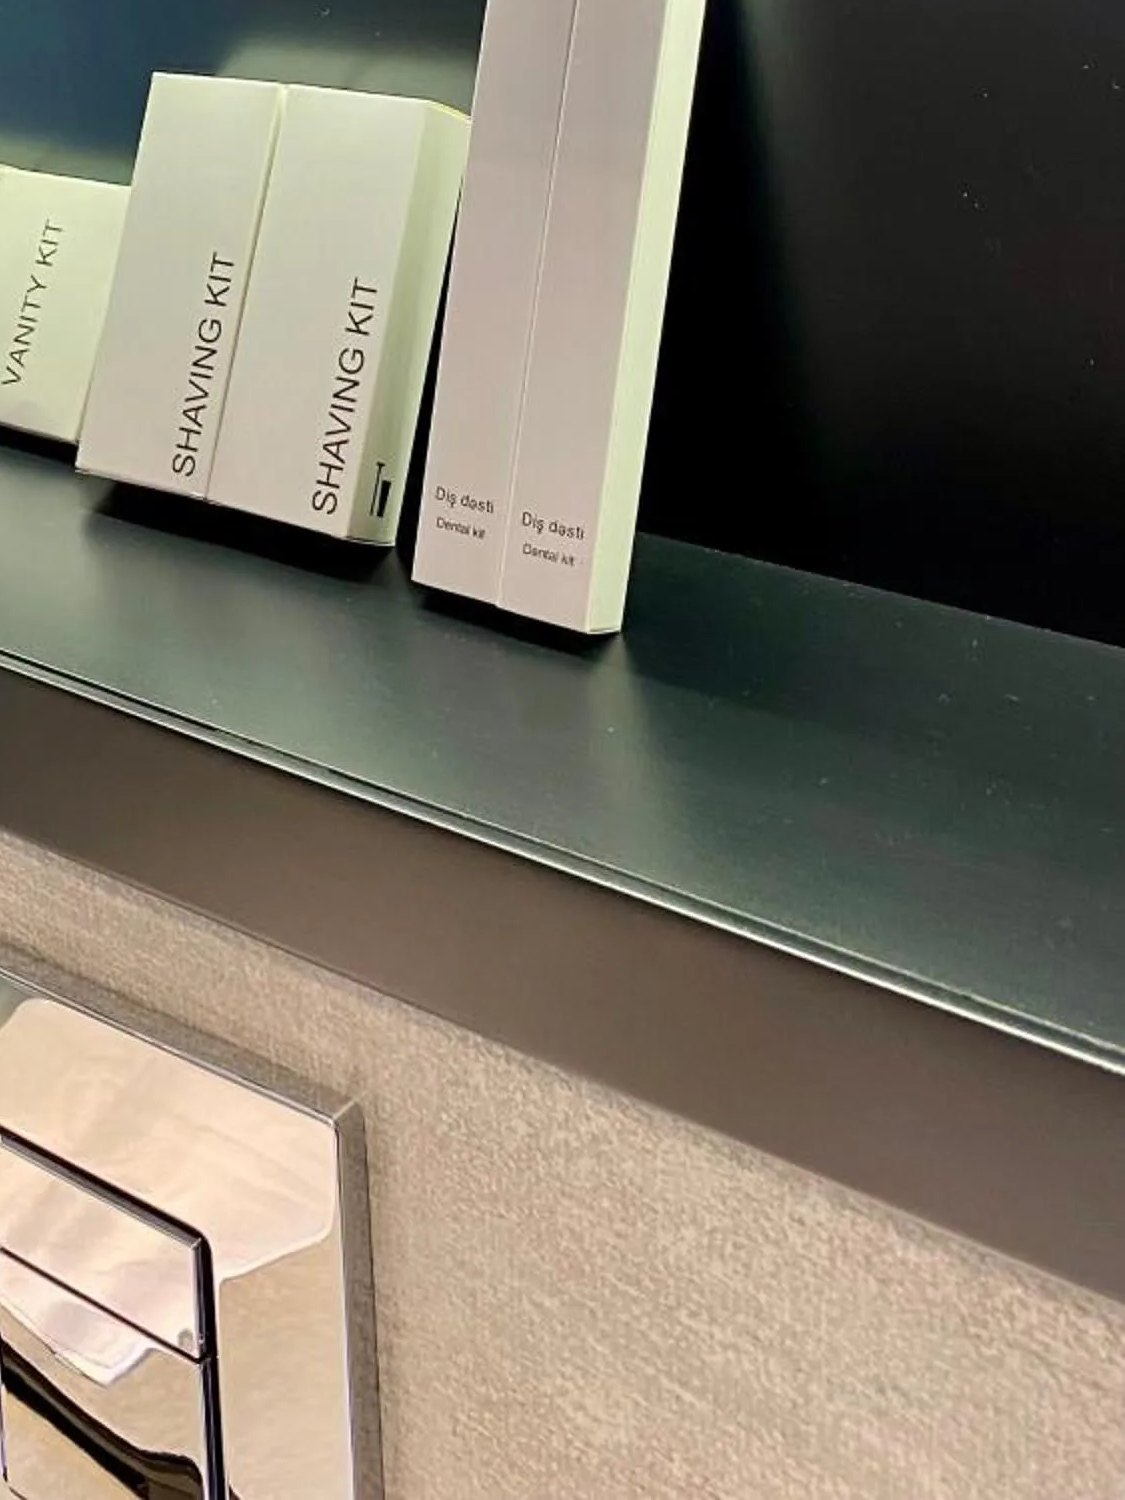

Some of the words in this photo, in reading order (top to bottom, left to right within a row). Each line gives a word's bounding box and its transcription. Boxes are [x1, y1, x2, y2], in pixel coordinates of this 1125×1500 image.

[0, 273, 48, 386] VANITY
[35, 218, 64, 268] KIT
[172, 317, 223, 478] SHAVING
[204, 251, 236, 308] KIT
[311, 347, 366, 516] SHAVING
[344, 276, 379, 337] KIT
[436, 516, 470, 536] Dental
[522, 543, 559, 563] Dental
